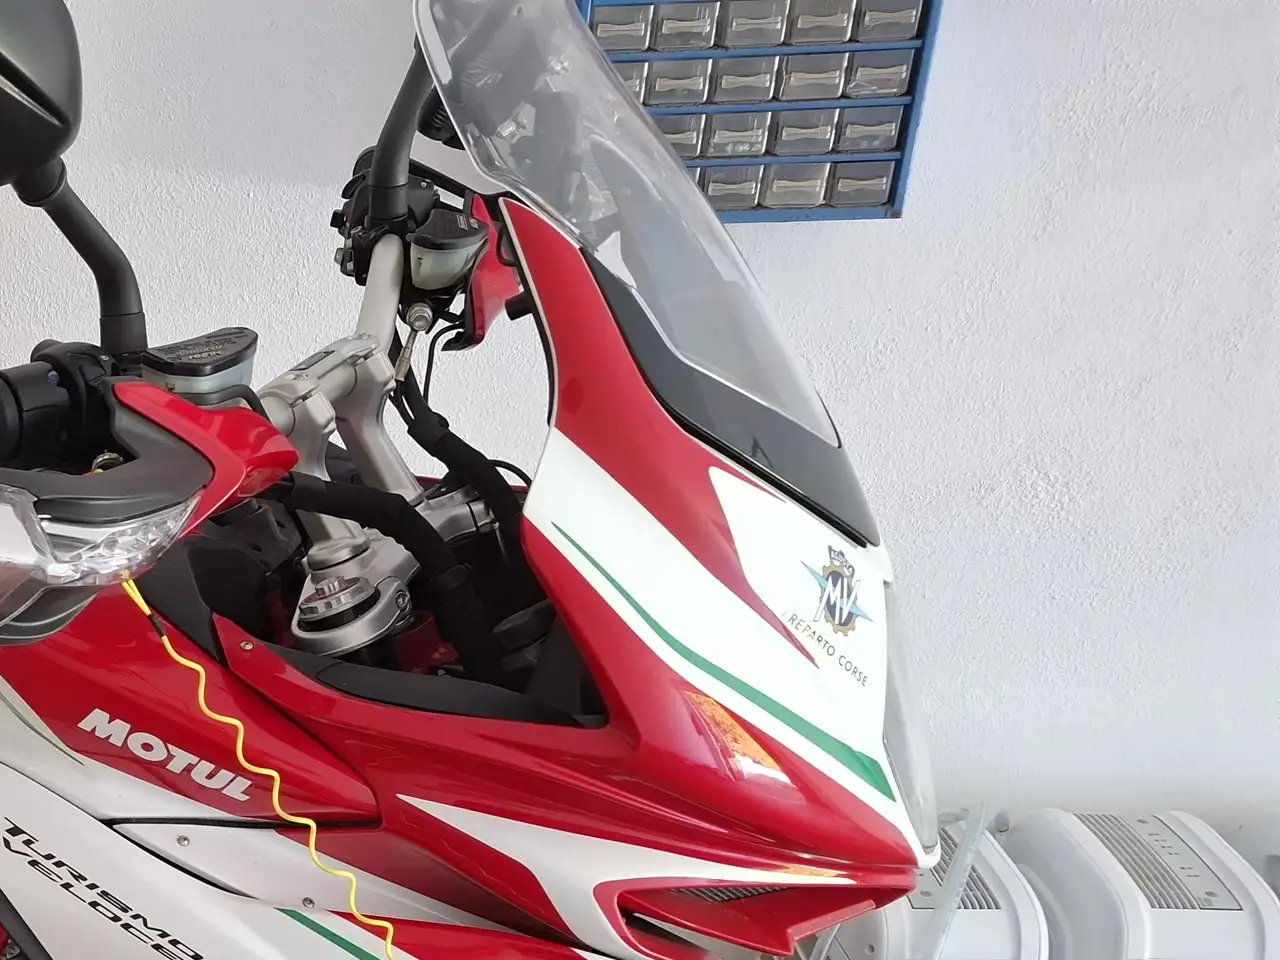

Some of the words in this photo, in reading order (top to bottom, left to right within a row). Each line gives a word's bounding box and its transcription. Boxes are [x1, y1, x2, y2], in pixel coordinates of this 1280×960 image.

[787, 613, 836, 656] REPARTO
[838, 655, 868, 687] CORSE
[77, 708, 252, 802] MOTUL
